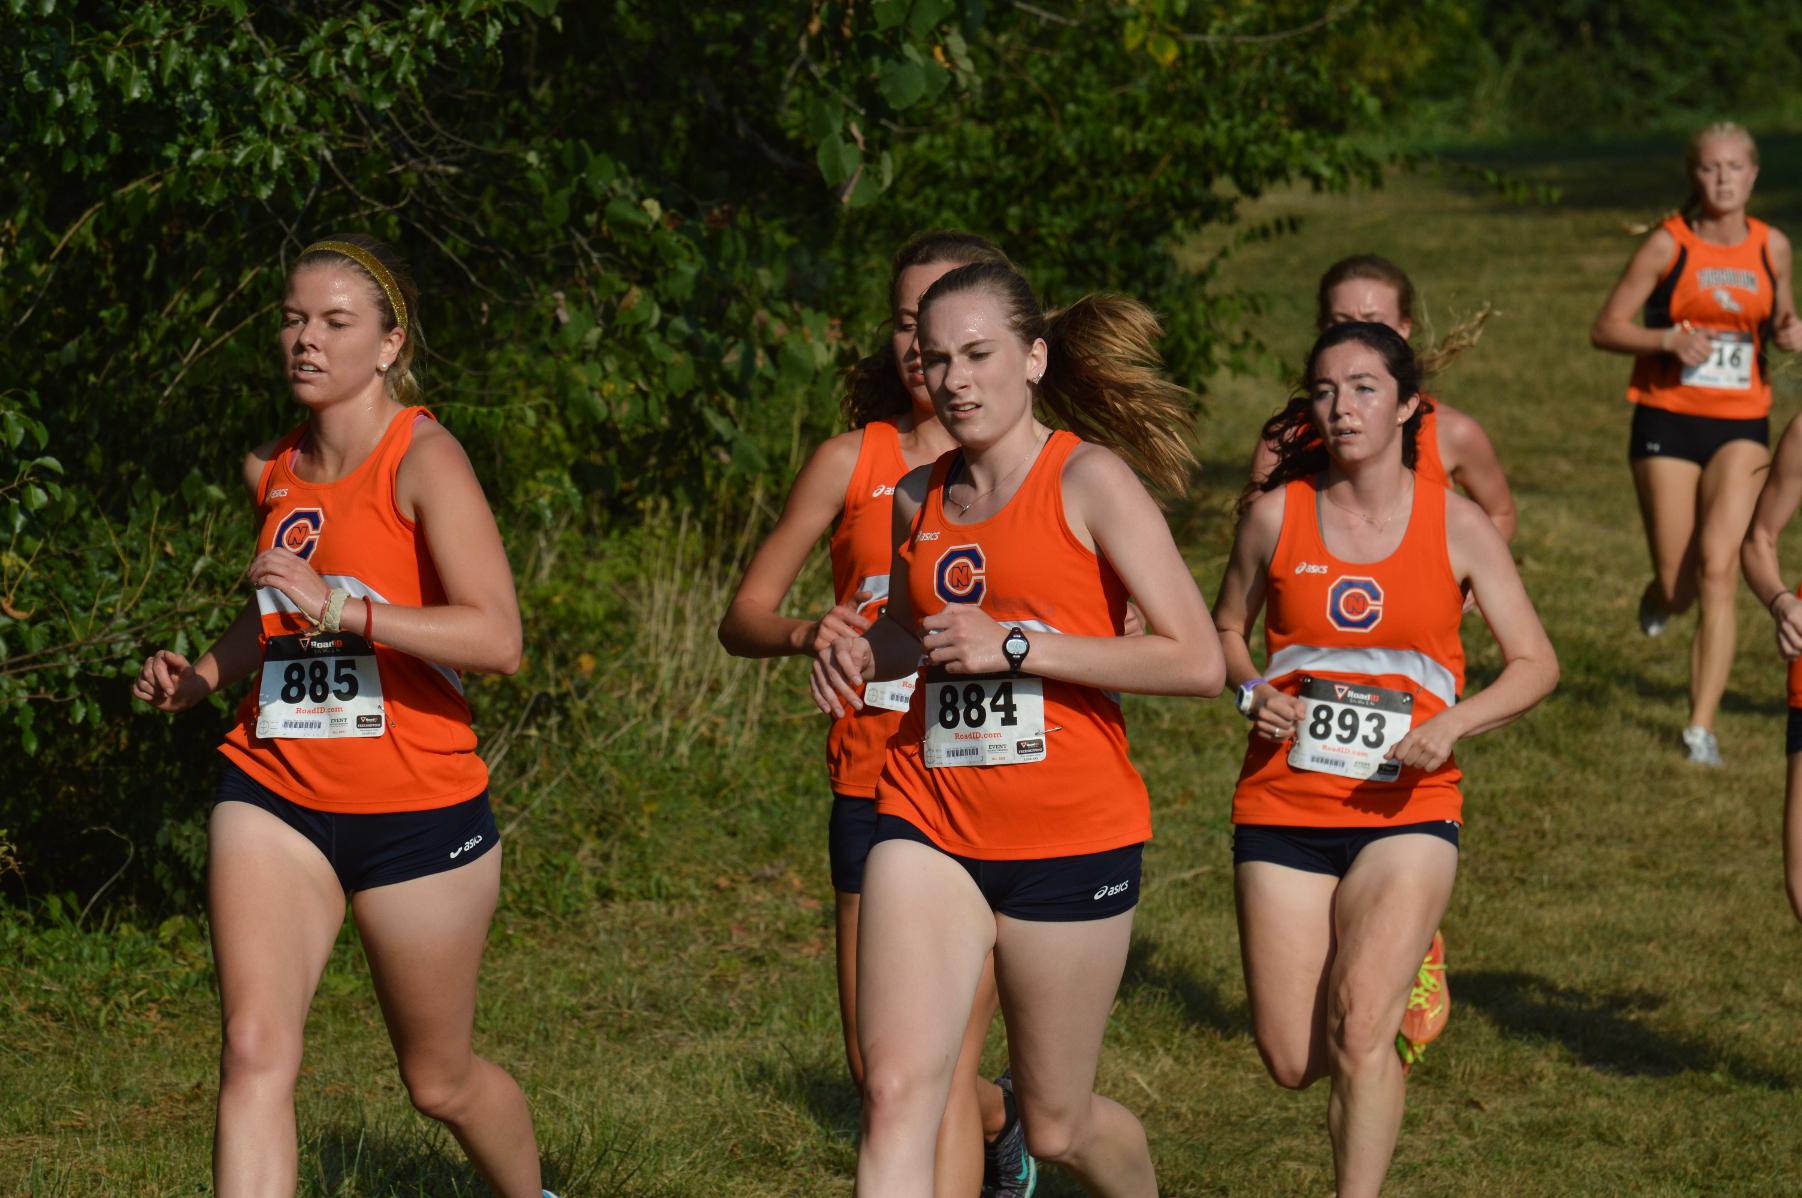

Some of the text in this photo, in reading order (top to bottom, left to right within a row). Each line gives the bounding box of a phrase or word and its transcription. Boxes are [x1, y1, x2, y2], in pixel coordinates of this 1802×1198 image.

[1715, 346, 1742, 368] 16
[1305, 564, 1328, 574] asics
[281, 659, 359, 704] 885
[295, 706, 344, 715] RoadID.com
[938, 681, 1018, 729] 884
[954, 731, 1003, 741] RoadID.com
[1308, 704, 1387, 749] 893
